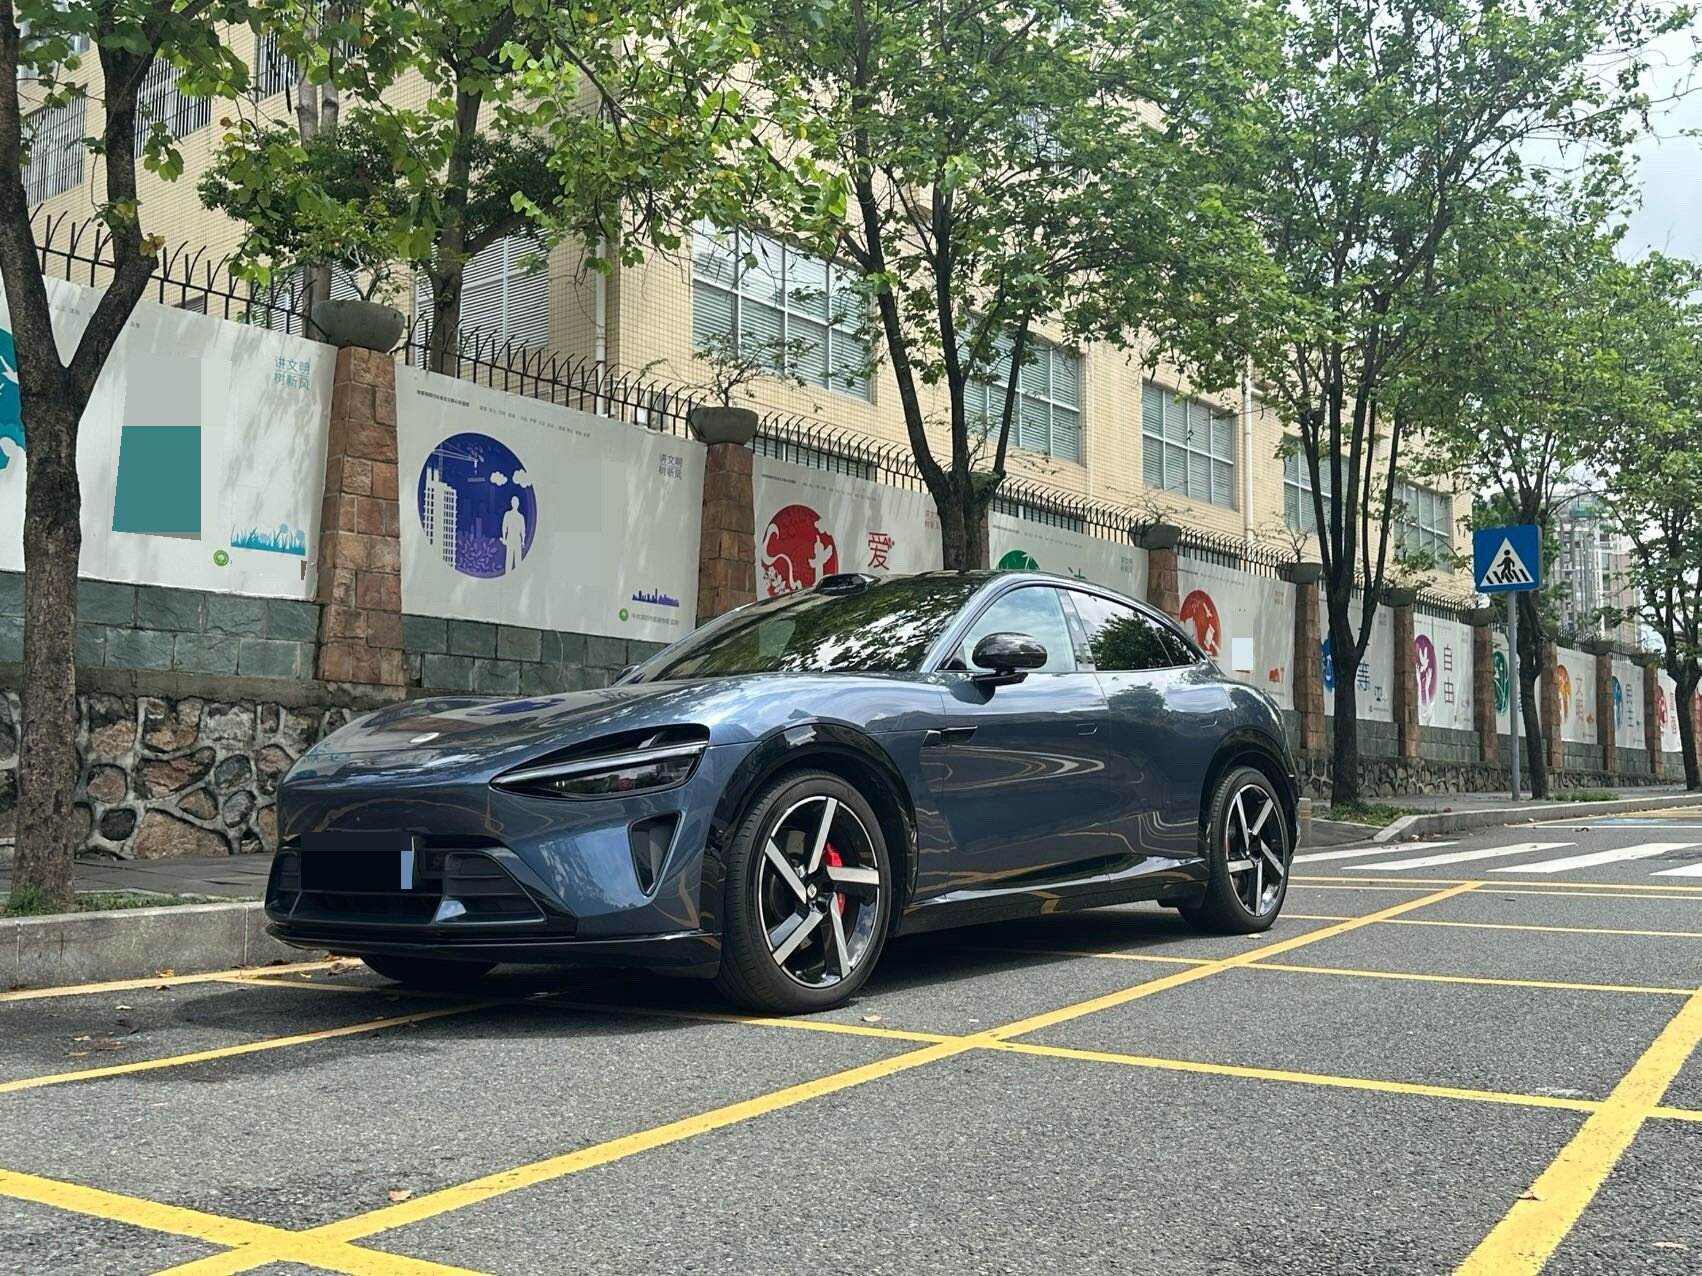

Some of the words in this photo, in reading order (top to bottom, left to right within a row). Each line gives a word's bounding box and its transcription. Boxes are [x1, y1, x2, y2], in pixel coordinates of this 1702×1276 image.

[274, 355, 310, 374] 讲文明
[868, 531, 893, 571] 爱
[1443, 643, 1455, 704] 自由
